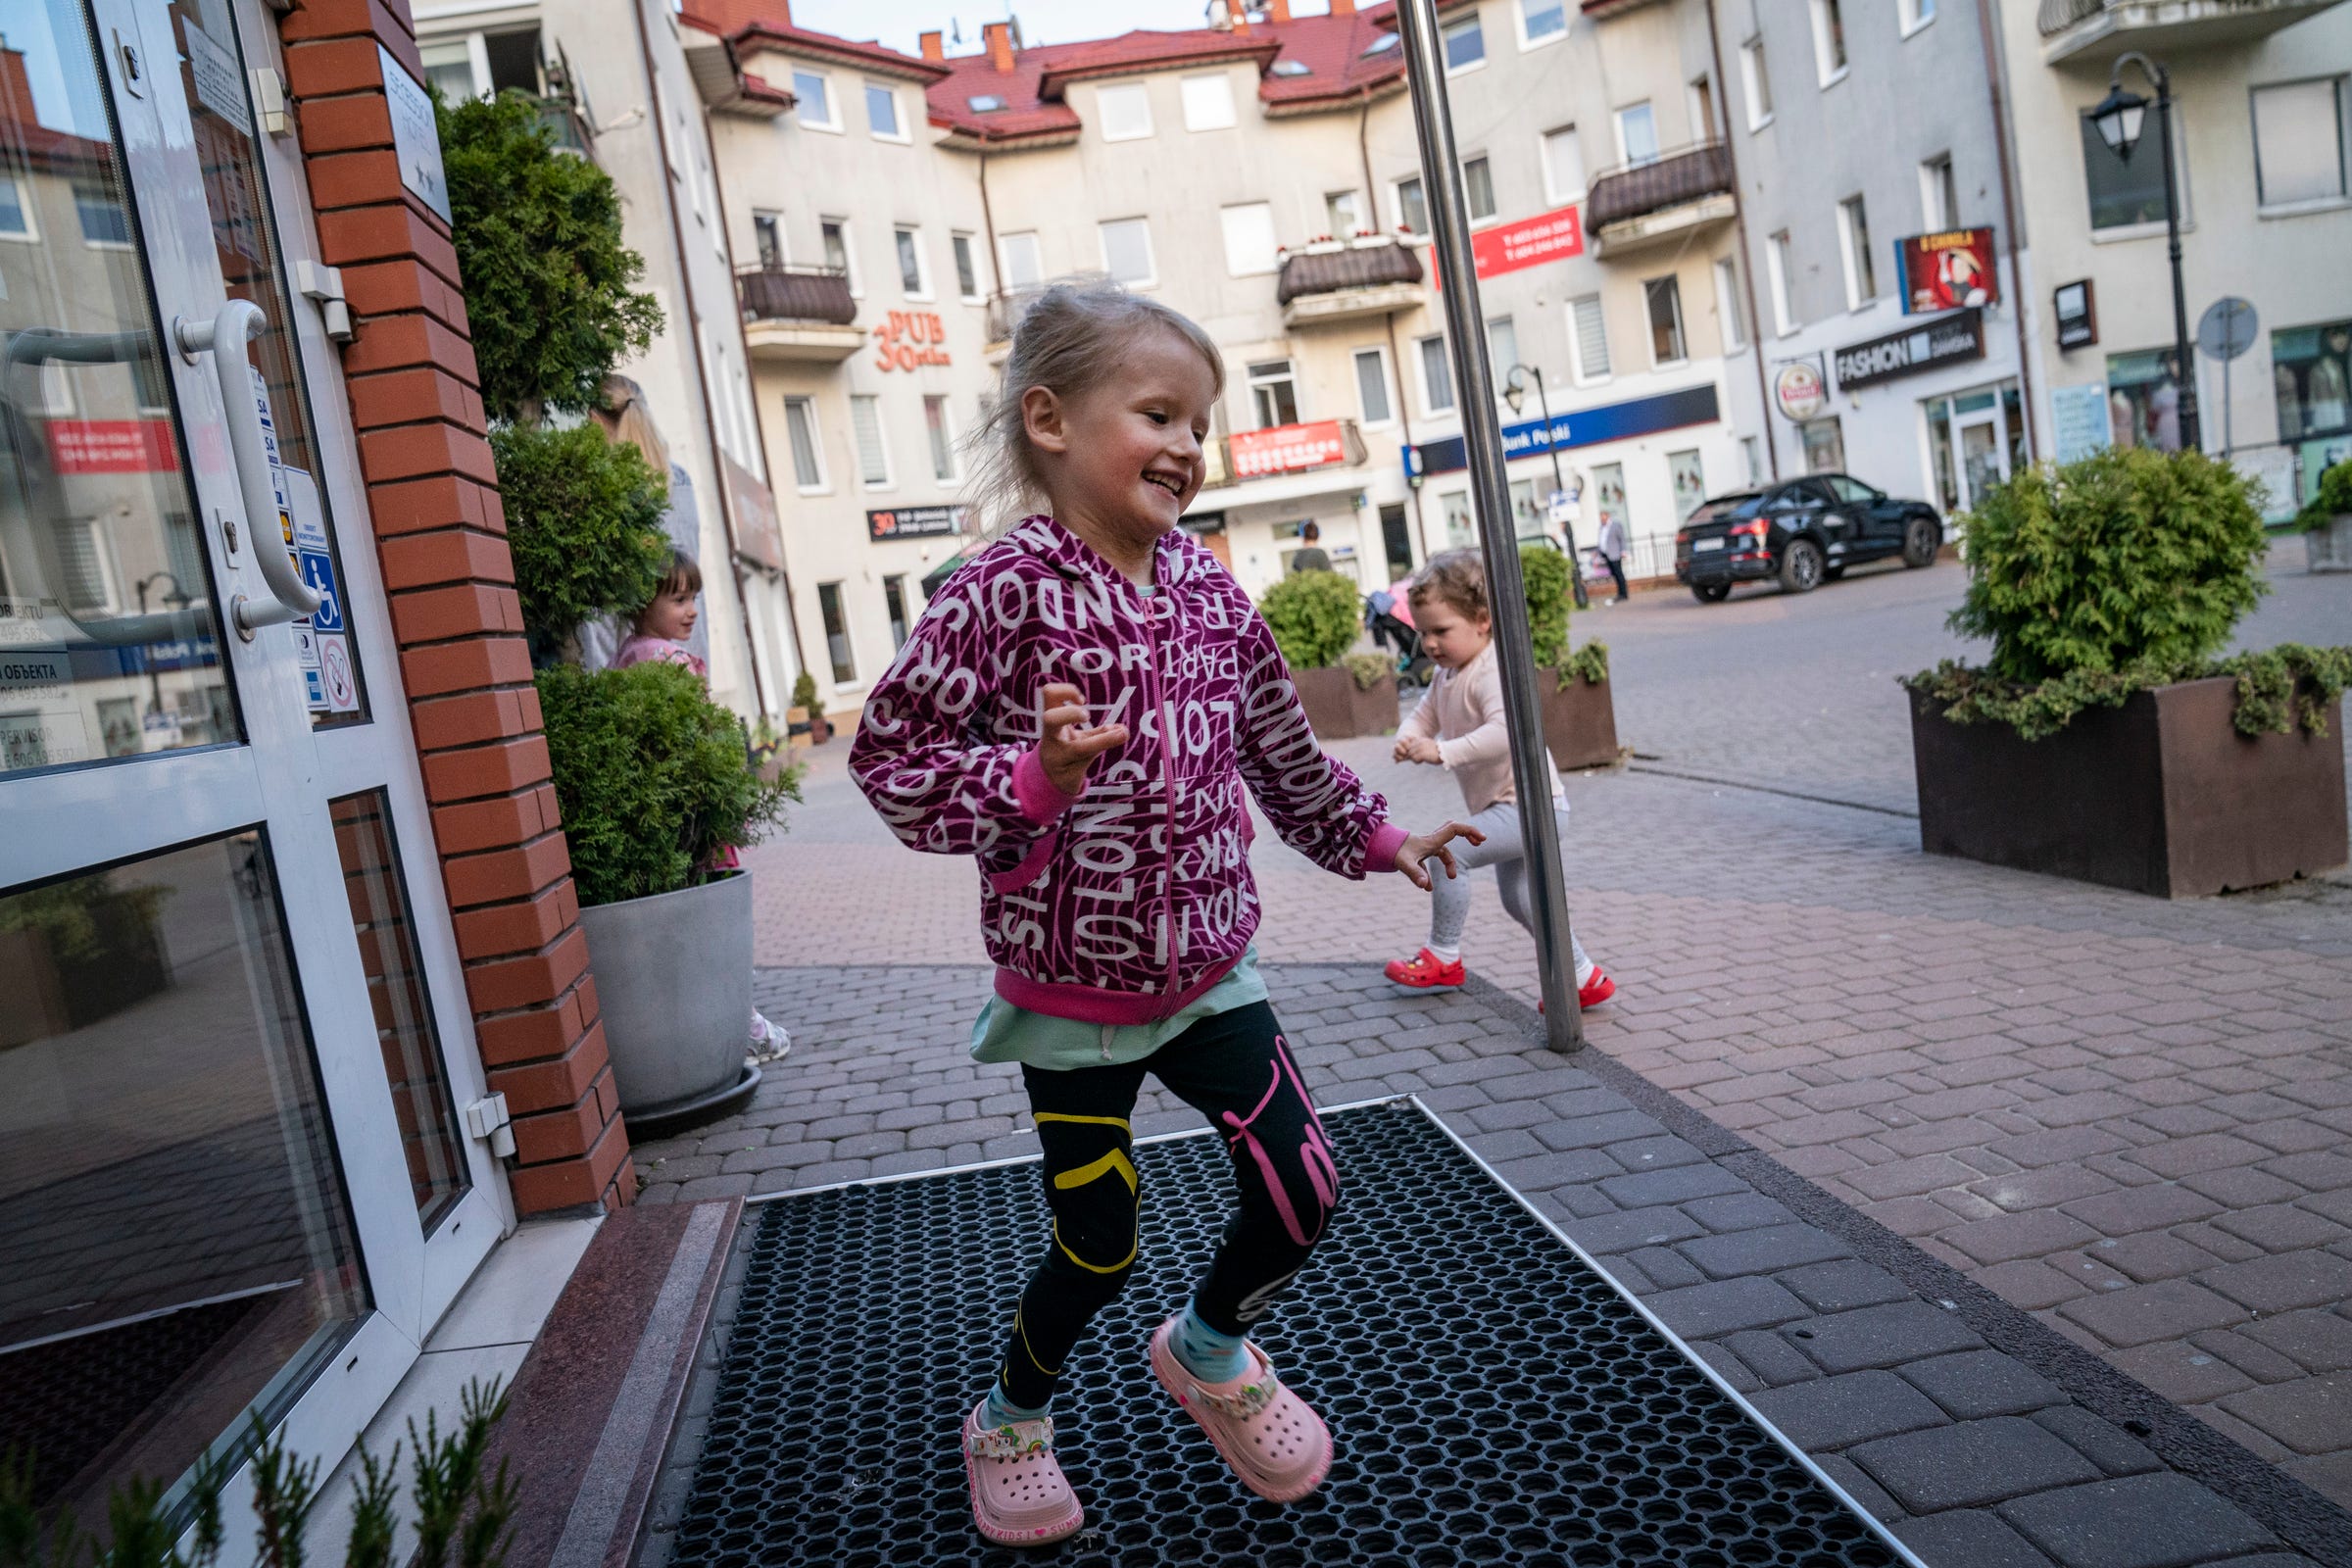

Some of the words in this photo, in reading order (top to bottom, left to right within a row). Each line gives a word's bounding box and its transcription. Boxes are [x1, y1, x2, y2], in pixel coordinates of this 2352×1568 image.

[888, 310, 946, 344] PUB
[1837, 338, 1909, 383] FASHION
[4, 663, 58, 680] ОБЪЕКТА
[1239, 651, 1338, 818] LONDON
[997, 1529, 1023, 1540] KIDS
